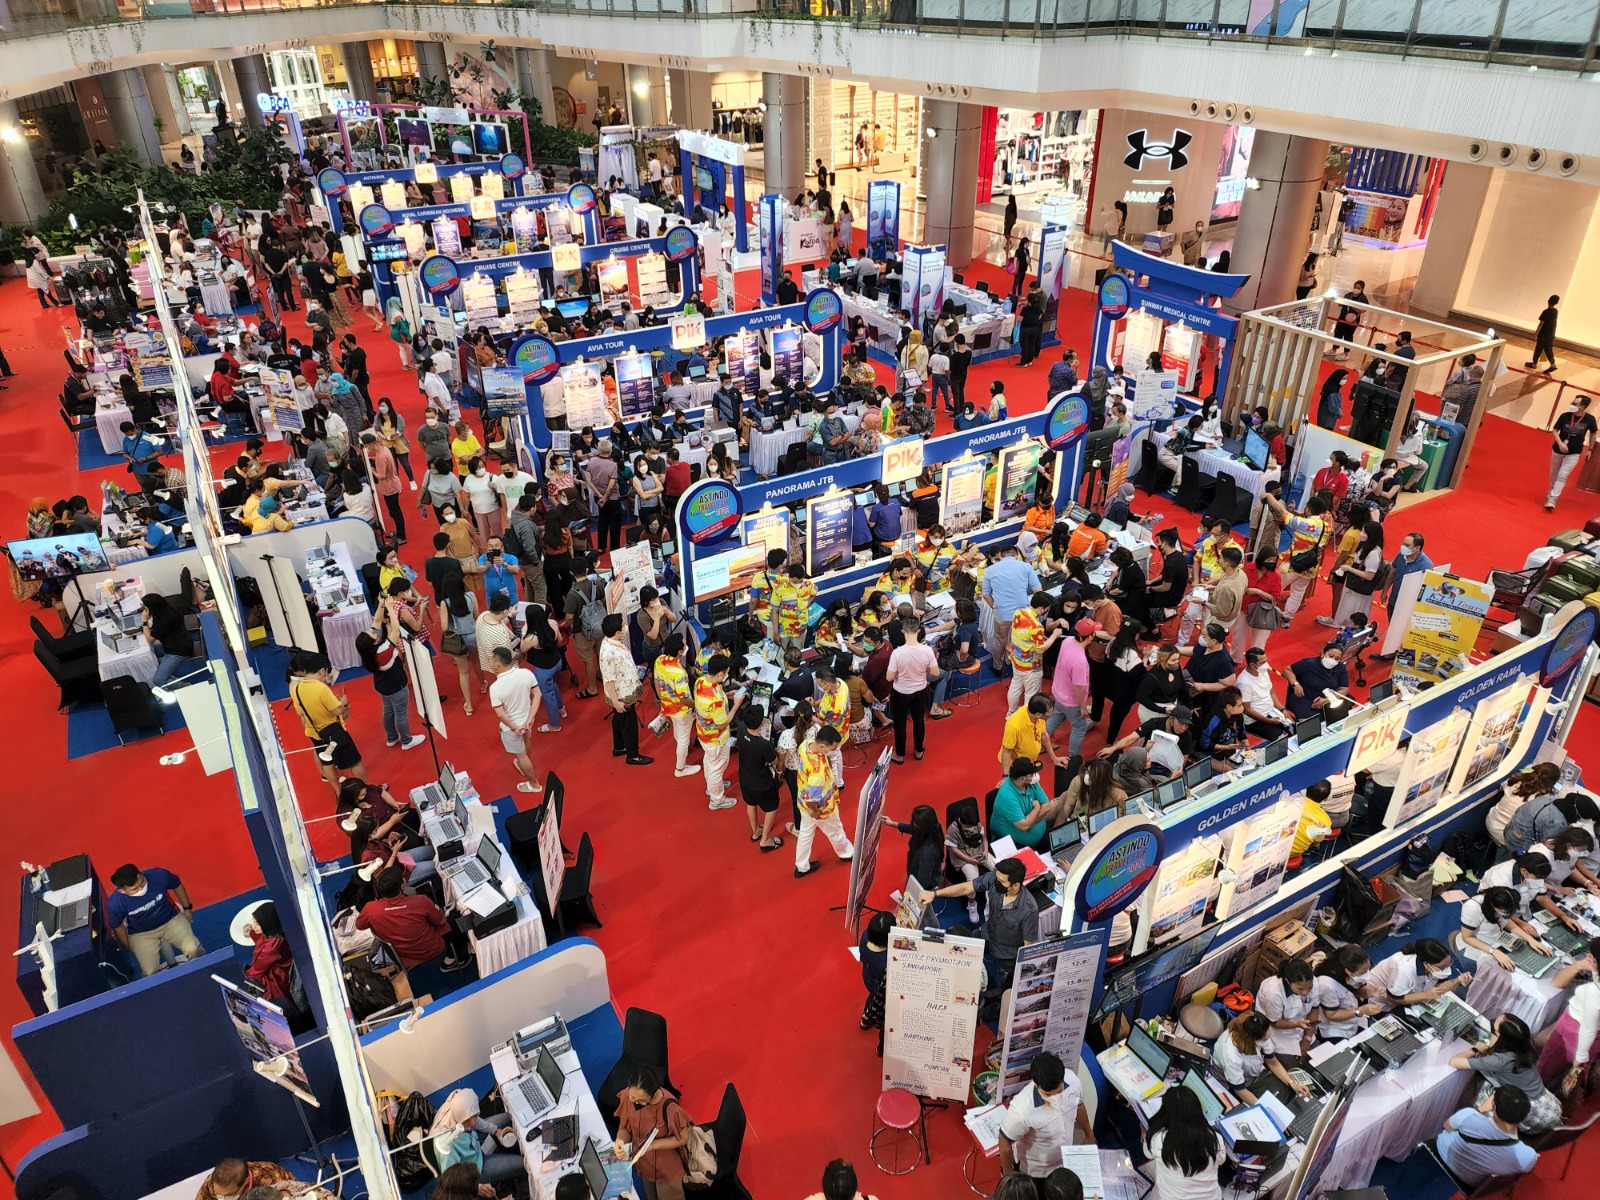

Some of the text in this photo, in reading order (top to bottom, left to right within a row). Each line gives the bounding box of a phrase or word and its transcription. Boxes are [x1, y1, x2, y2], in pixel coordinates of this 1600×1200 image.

[270, 96, 290, 110] BCA
[610, 243, 651, 253] CRUISE CENTRE
[555, 249, 578, 263] PIK
[474, 260, 521, 271] CRUISE CENTRE
[749, 313, 782, 324] AVIA TOUR
[1141, 299, 1211, 327] SUNWAY MEDICAL CENTRE
[675, 322, 702, 340] PIK
[587, 340, 624, 352] AVIA TOUR
[969, 425, 1026, 447] PANORAMA JTB
[887, 447, 919, 472] PIK
[766, 475, 834, 499] PANORAMA JTB
[699, 490, 729, 503] ASTINDO
[1457, 600, 1484, 613] Tours
[1392, 674, 1421, 683] HARGA
[1457, 664, 1522, 703] GOLDEN RAMA
[1356, 717, 1402, 760] PIK
[1197, 782, 1284, 832] GOLDEN RAMA
[1108, 834, 1150, 864] ASTINDO
[1105, 848, 1148, 875] TRAVEL FAIR
[1127, 859, 1146, 874] 2022
[900, 952, 972, 968] HOTEL PROMOTION
[902, 962, 943, 974] SINGAPORE
[927, 1002, 948, 1011] BALI
[903, 1032, 935, 1042] BANDUNG
[923, 1063, 951, 1073] PUNCAK
